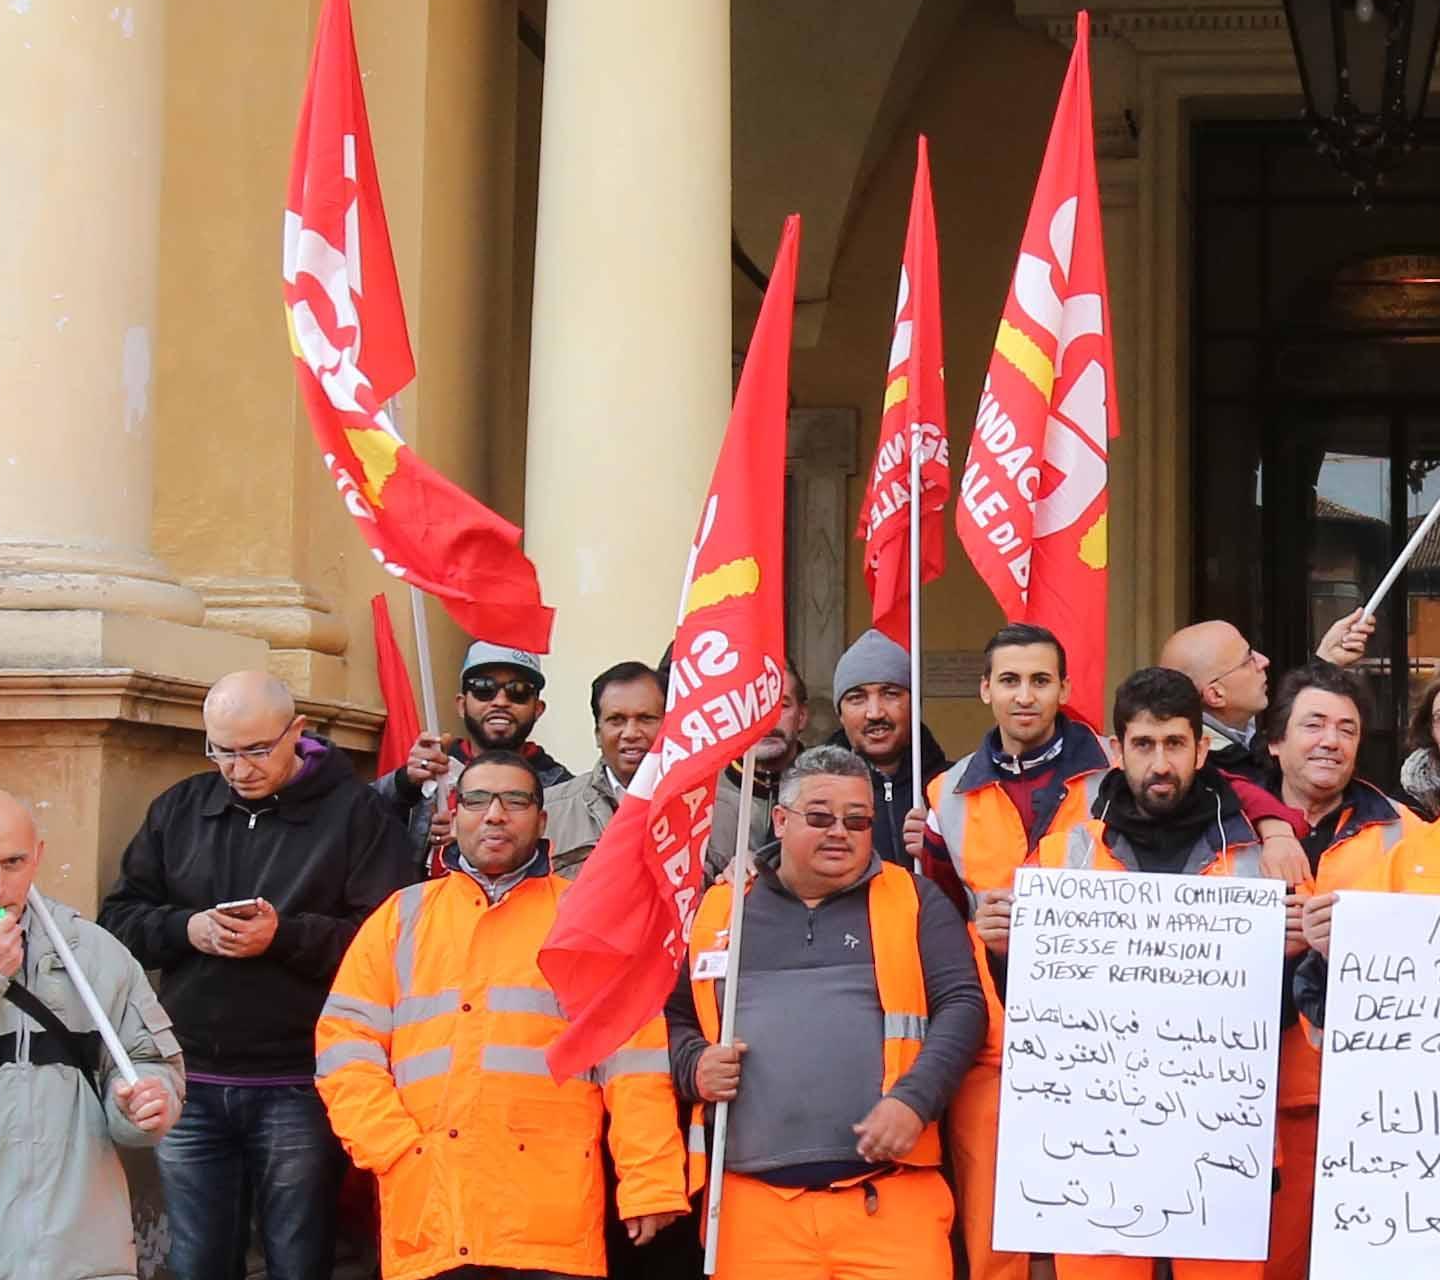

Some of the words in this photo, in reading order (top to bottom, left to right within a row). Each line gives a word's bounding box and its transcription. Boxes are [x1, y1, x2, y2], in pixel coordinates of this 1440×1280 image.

[988, 522, 1021, 555] DI
[1018, 872, 1161, 905] LAVORATORI
[1174, 882, 1280, 908] COMMITTENZA
[1014, 907, 1025, 929] E
[1034, 909, 1137, 930] LAVORATORI
[1147, 913, 1159, 931] IN
[1165, 914, 1252, 935] APPALTO
[1034, 935, 1118, 957] STESSE
[1127, 937, 1222, 961] MANSIONI
[1030, 960, 1098, 981] STESSE
[1109, 965, 1247, 988] RETRIBUZIONI
[1339, 951, 1416, 984] ALLA
[1110, 1010, 1140, 1040] في
[1331, 1030, 1412, 1054] DELLE
[1125, 1056, 1150, 1078] في
